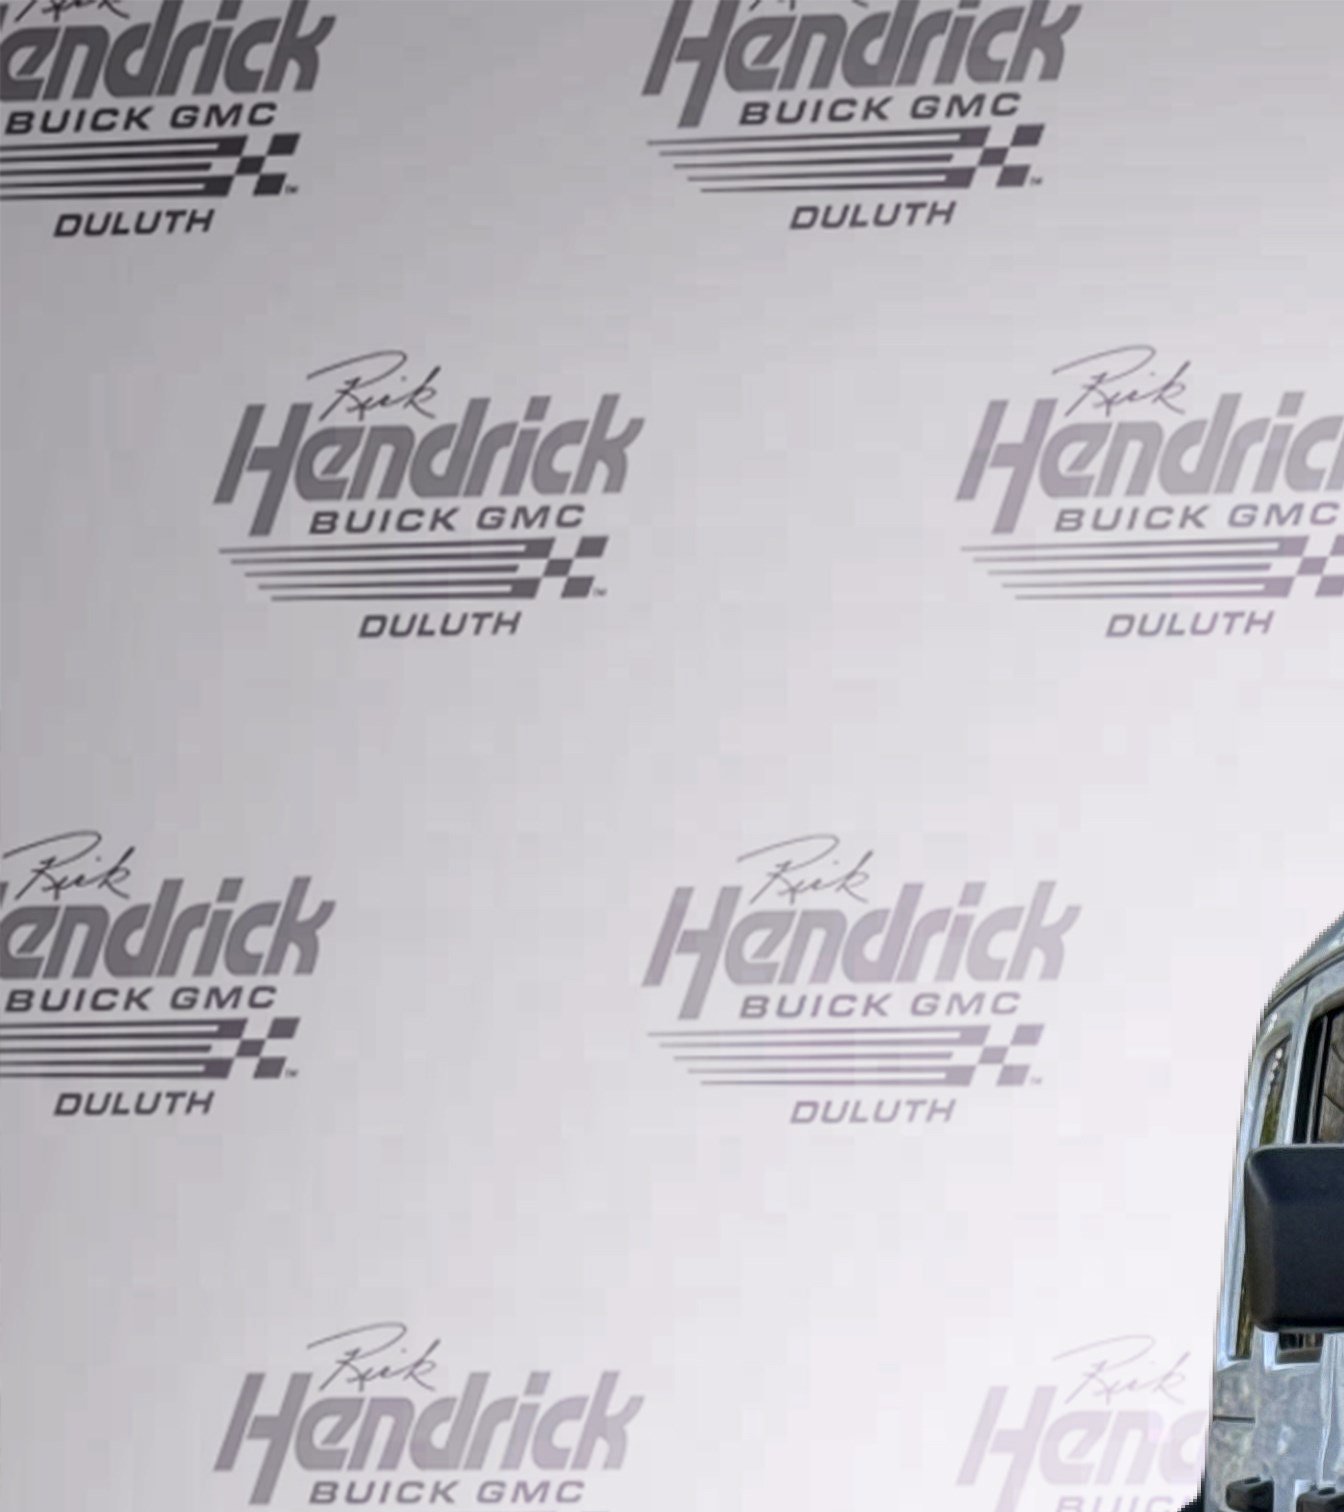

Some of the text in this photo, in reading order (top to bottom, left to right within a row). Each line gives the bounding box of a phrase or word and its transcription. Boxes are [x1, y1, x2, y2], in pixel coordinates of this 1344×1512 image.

[0, 0, 336, 101] endrick
[642, 0, 1082, 128] Hendrick
[5, 102, 277, 135] BUICK GMC
[739, 92, 1021, 126] BUICK GMC
[54, 209, 215, 237] DULUTH
[790, 201, 956, 230] DULUTH
[214, 394, 644, 537] Hendrick
[309, 504, 585, 534] BUICK GMC
[1054, 502, 1340, 532] BUICK GMC
[359, 611, 522, 638] DULUTH
[1106, 611, 1274, 638] DULUTH
[0, 876, 335, 980] endrick
[642, 881, 1081, 1020] Hendrick
[5, 985, 277, 1013] BUICK GMC
[739, 992, 1021, 1019] BUICK GMC
[54, 1091, 214, 1116] DULUTH
[790, 1099, 956, 1124] DULUTH
[213, 1371, 644, 1505] Hendrick
[309, 1480, 585, 1505] BUICK GMC
